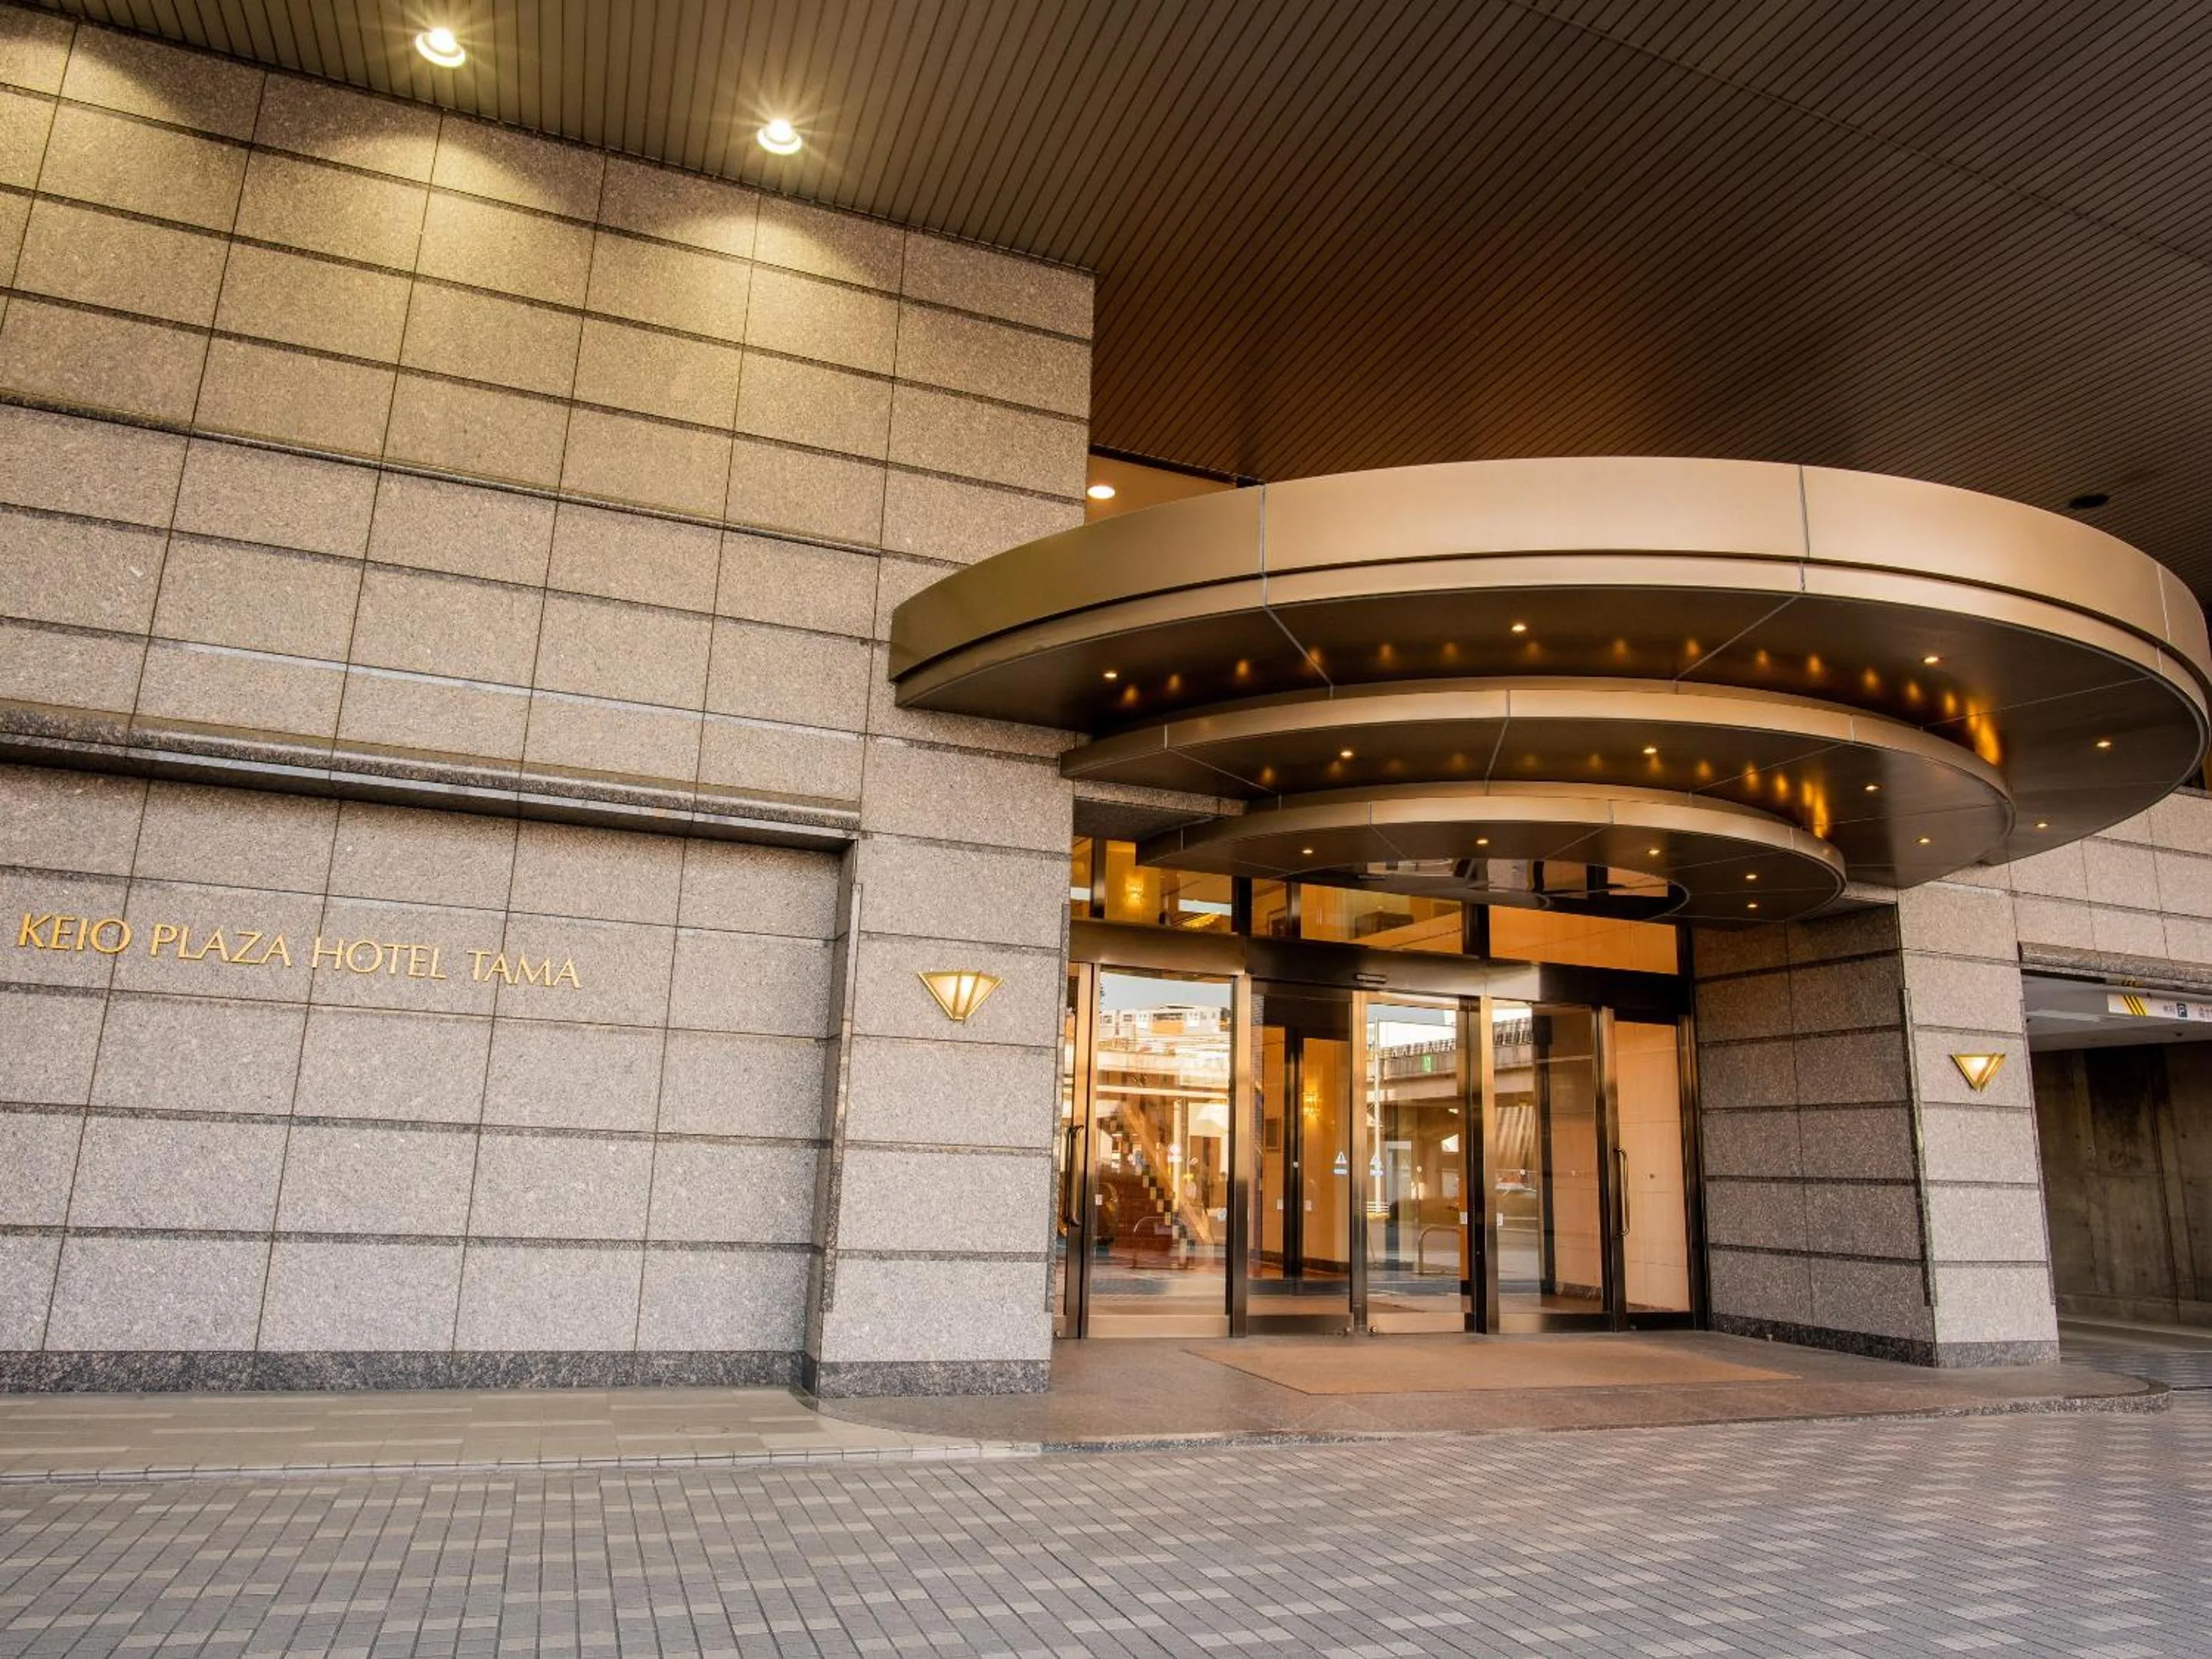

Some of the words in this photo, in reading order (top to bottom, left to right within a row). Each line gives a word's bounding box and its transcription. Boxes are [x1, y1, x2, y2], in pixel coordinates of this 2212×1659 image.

[18, 912, 133, 954] KEIO
[150, 923, 292, 967] PLAZA
[311, 936, 447, 979] HOTEL
[467, 950, 581, 989] TAMA
